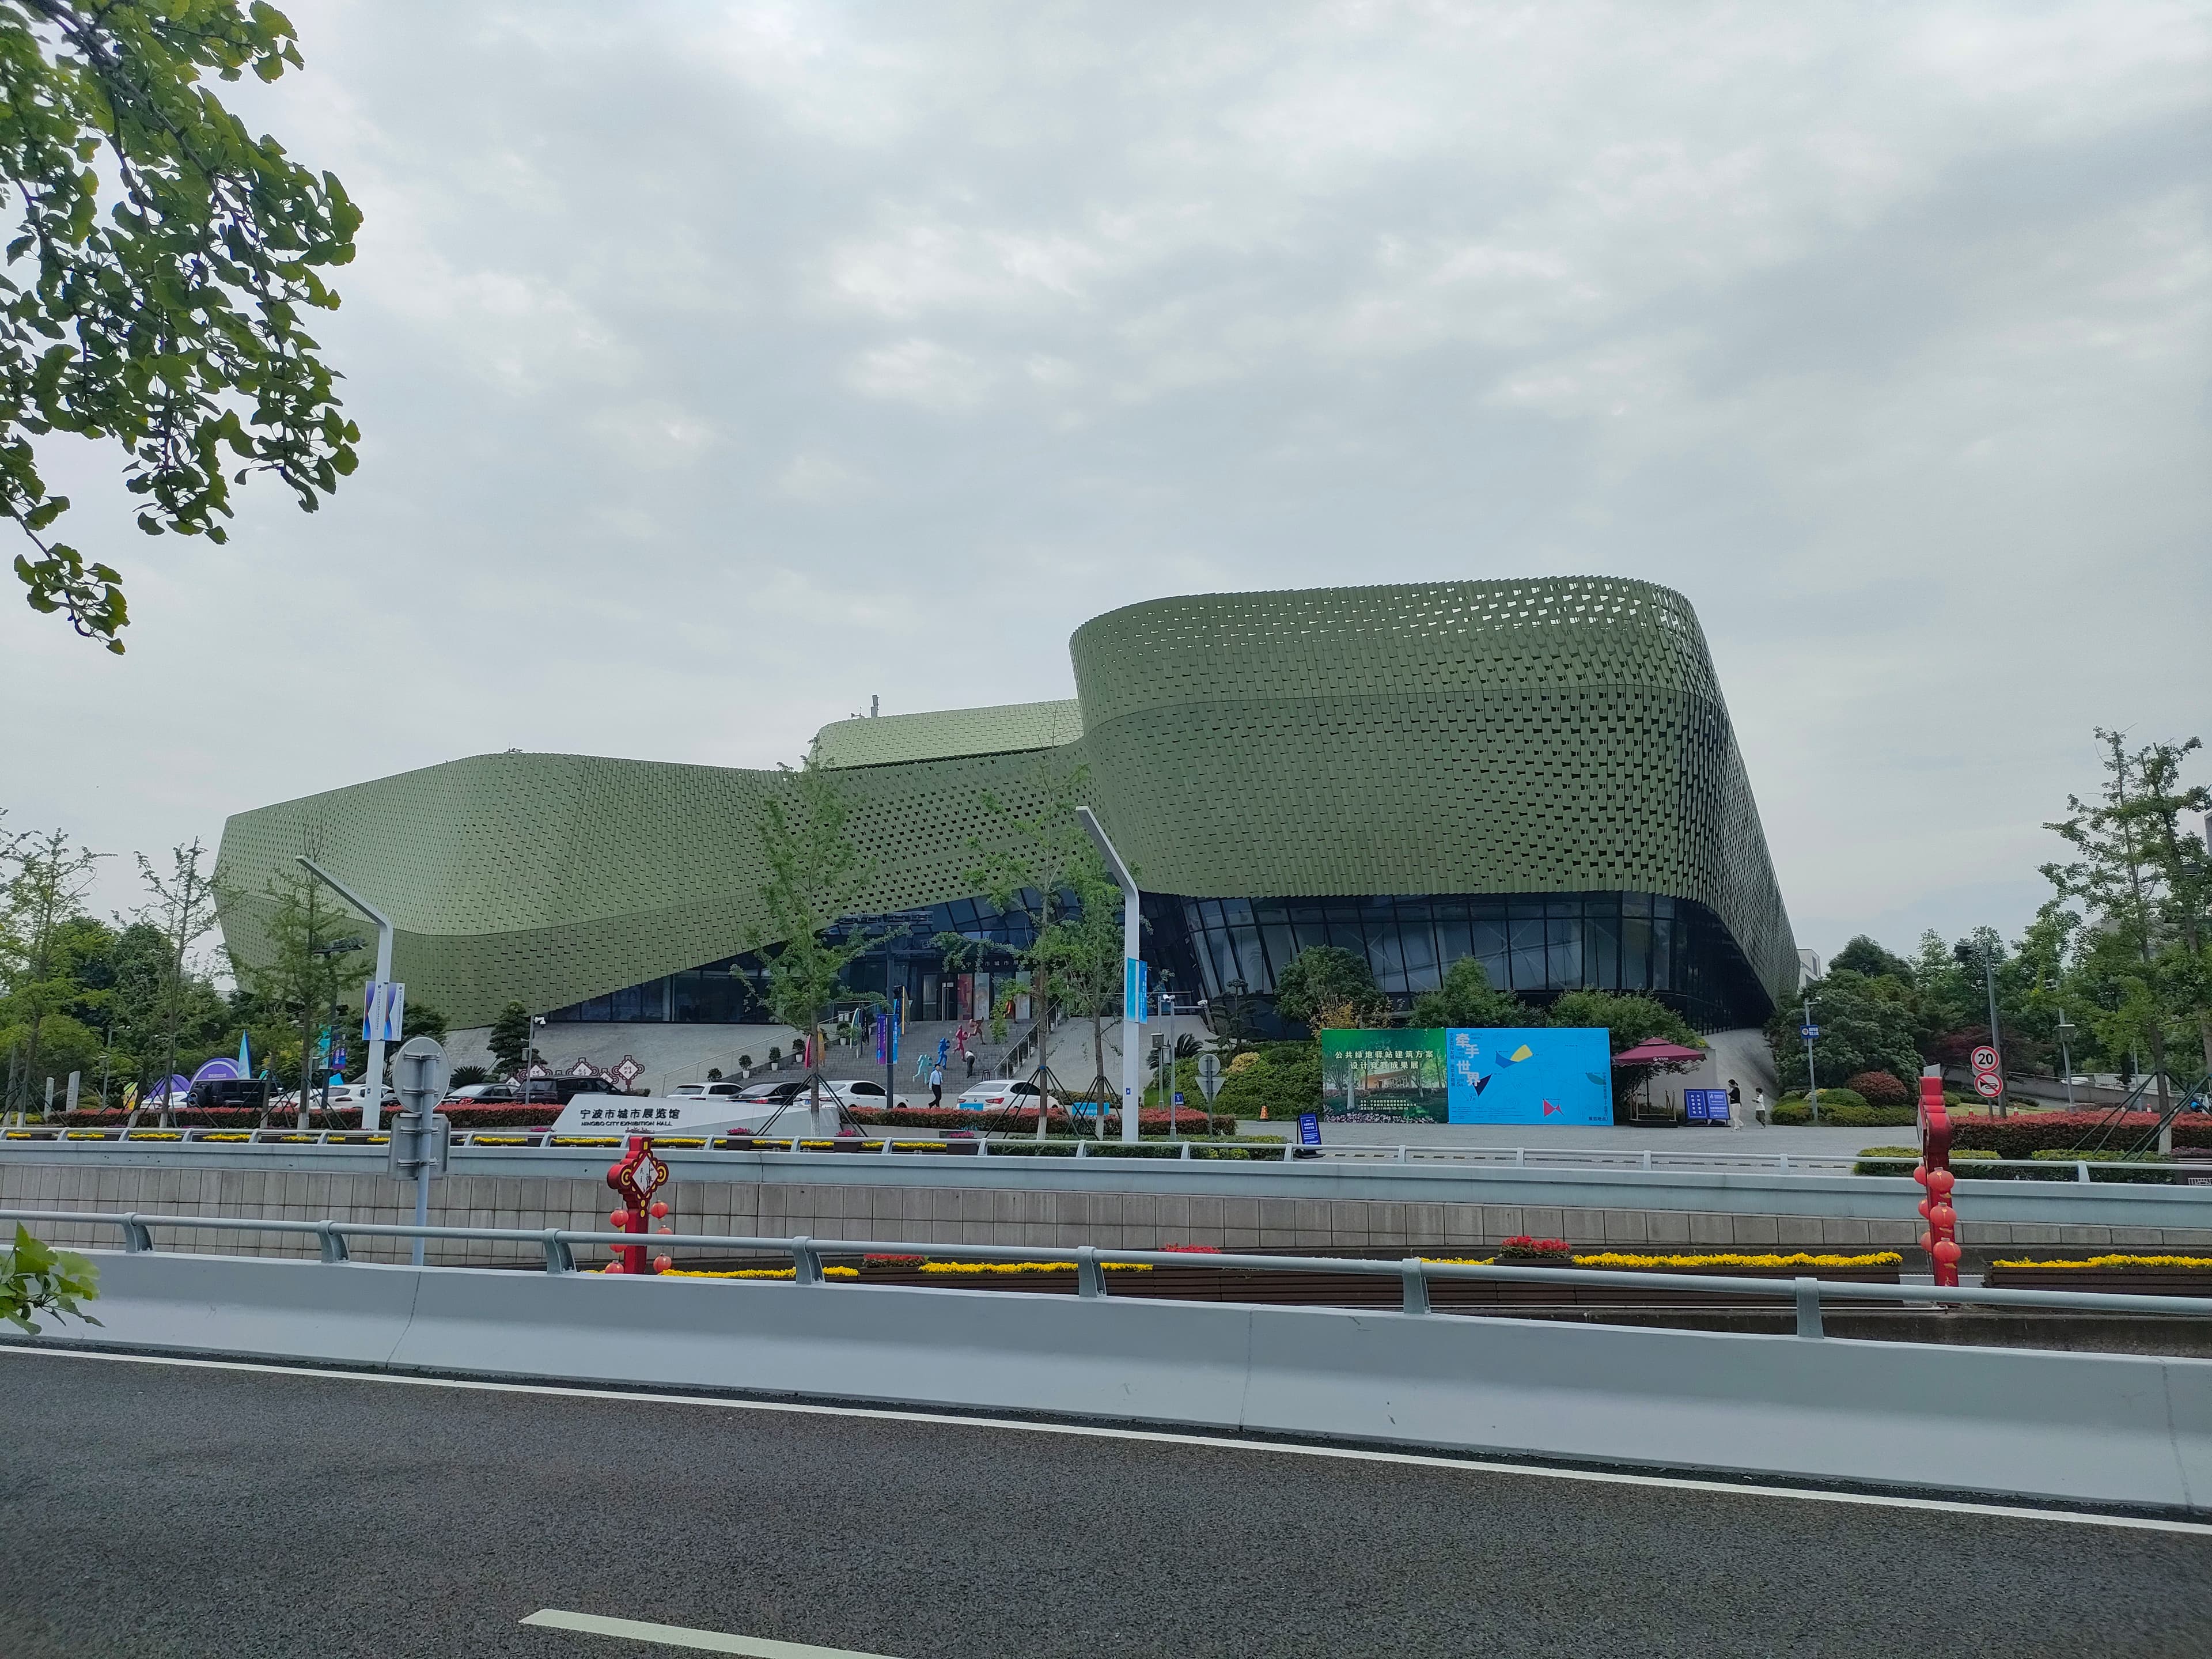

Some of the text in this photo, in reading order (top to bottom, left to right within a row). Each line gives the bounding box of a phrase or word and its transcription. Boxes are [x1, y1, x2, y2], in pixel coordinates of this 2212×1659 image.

[965, 960, 1038, 968] 宁市城市展馆
[1335, 1050, 1434, 1059] 公共绿地驿站建筑方案
[1978, 1053, 1993, 1065] 20
[1350, 1060, 1419, 1070] 设计竞赛成果展
[580, 1108, 680, 1119] 宁波市城市展览馆
